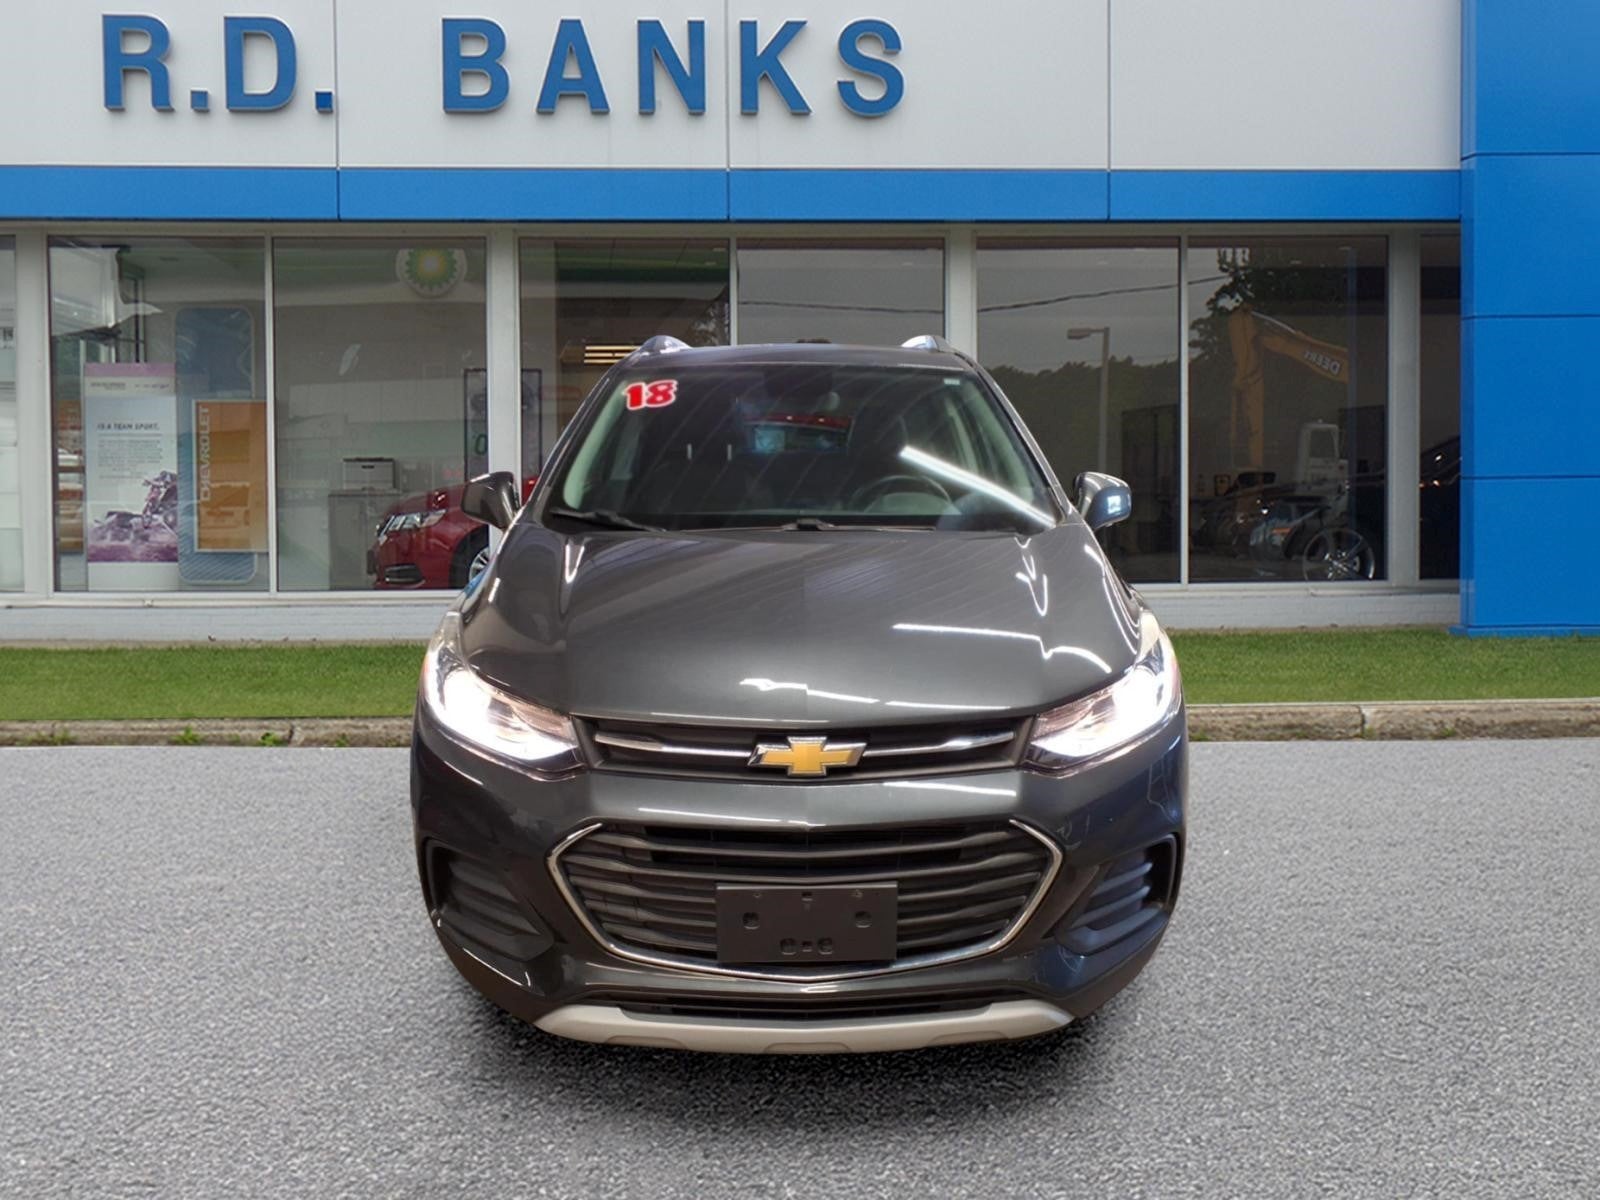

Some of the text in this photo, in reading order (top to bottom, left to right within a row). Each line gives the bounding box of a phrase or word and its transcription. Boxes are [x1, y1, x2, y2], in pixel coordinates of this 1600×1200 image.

[102, 15, 905, 116] R.D. BANKS
[623, 380, 678, 411] 18
[113, 423, 133, 431] TEAM
